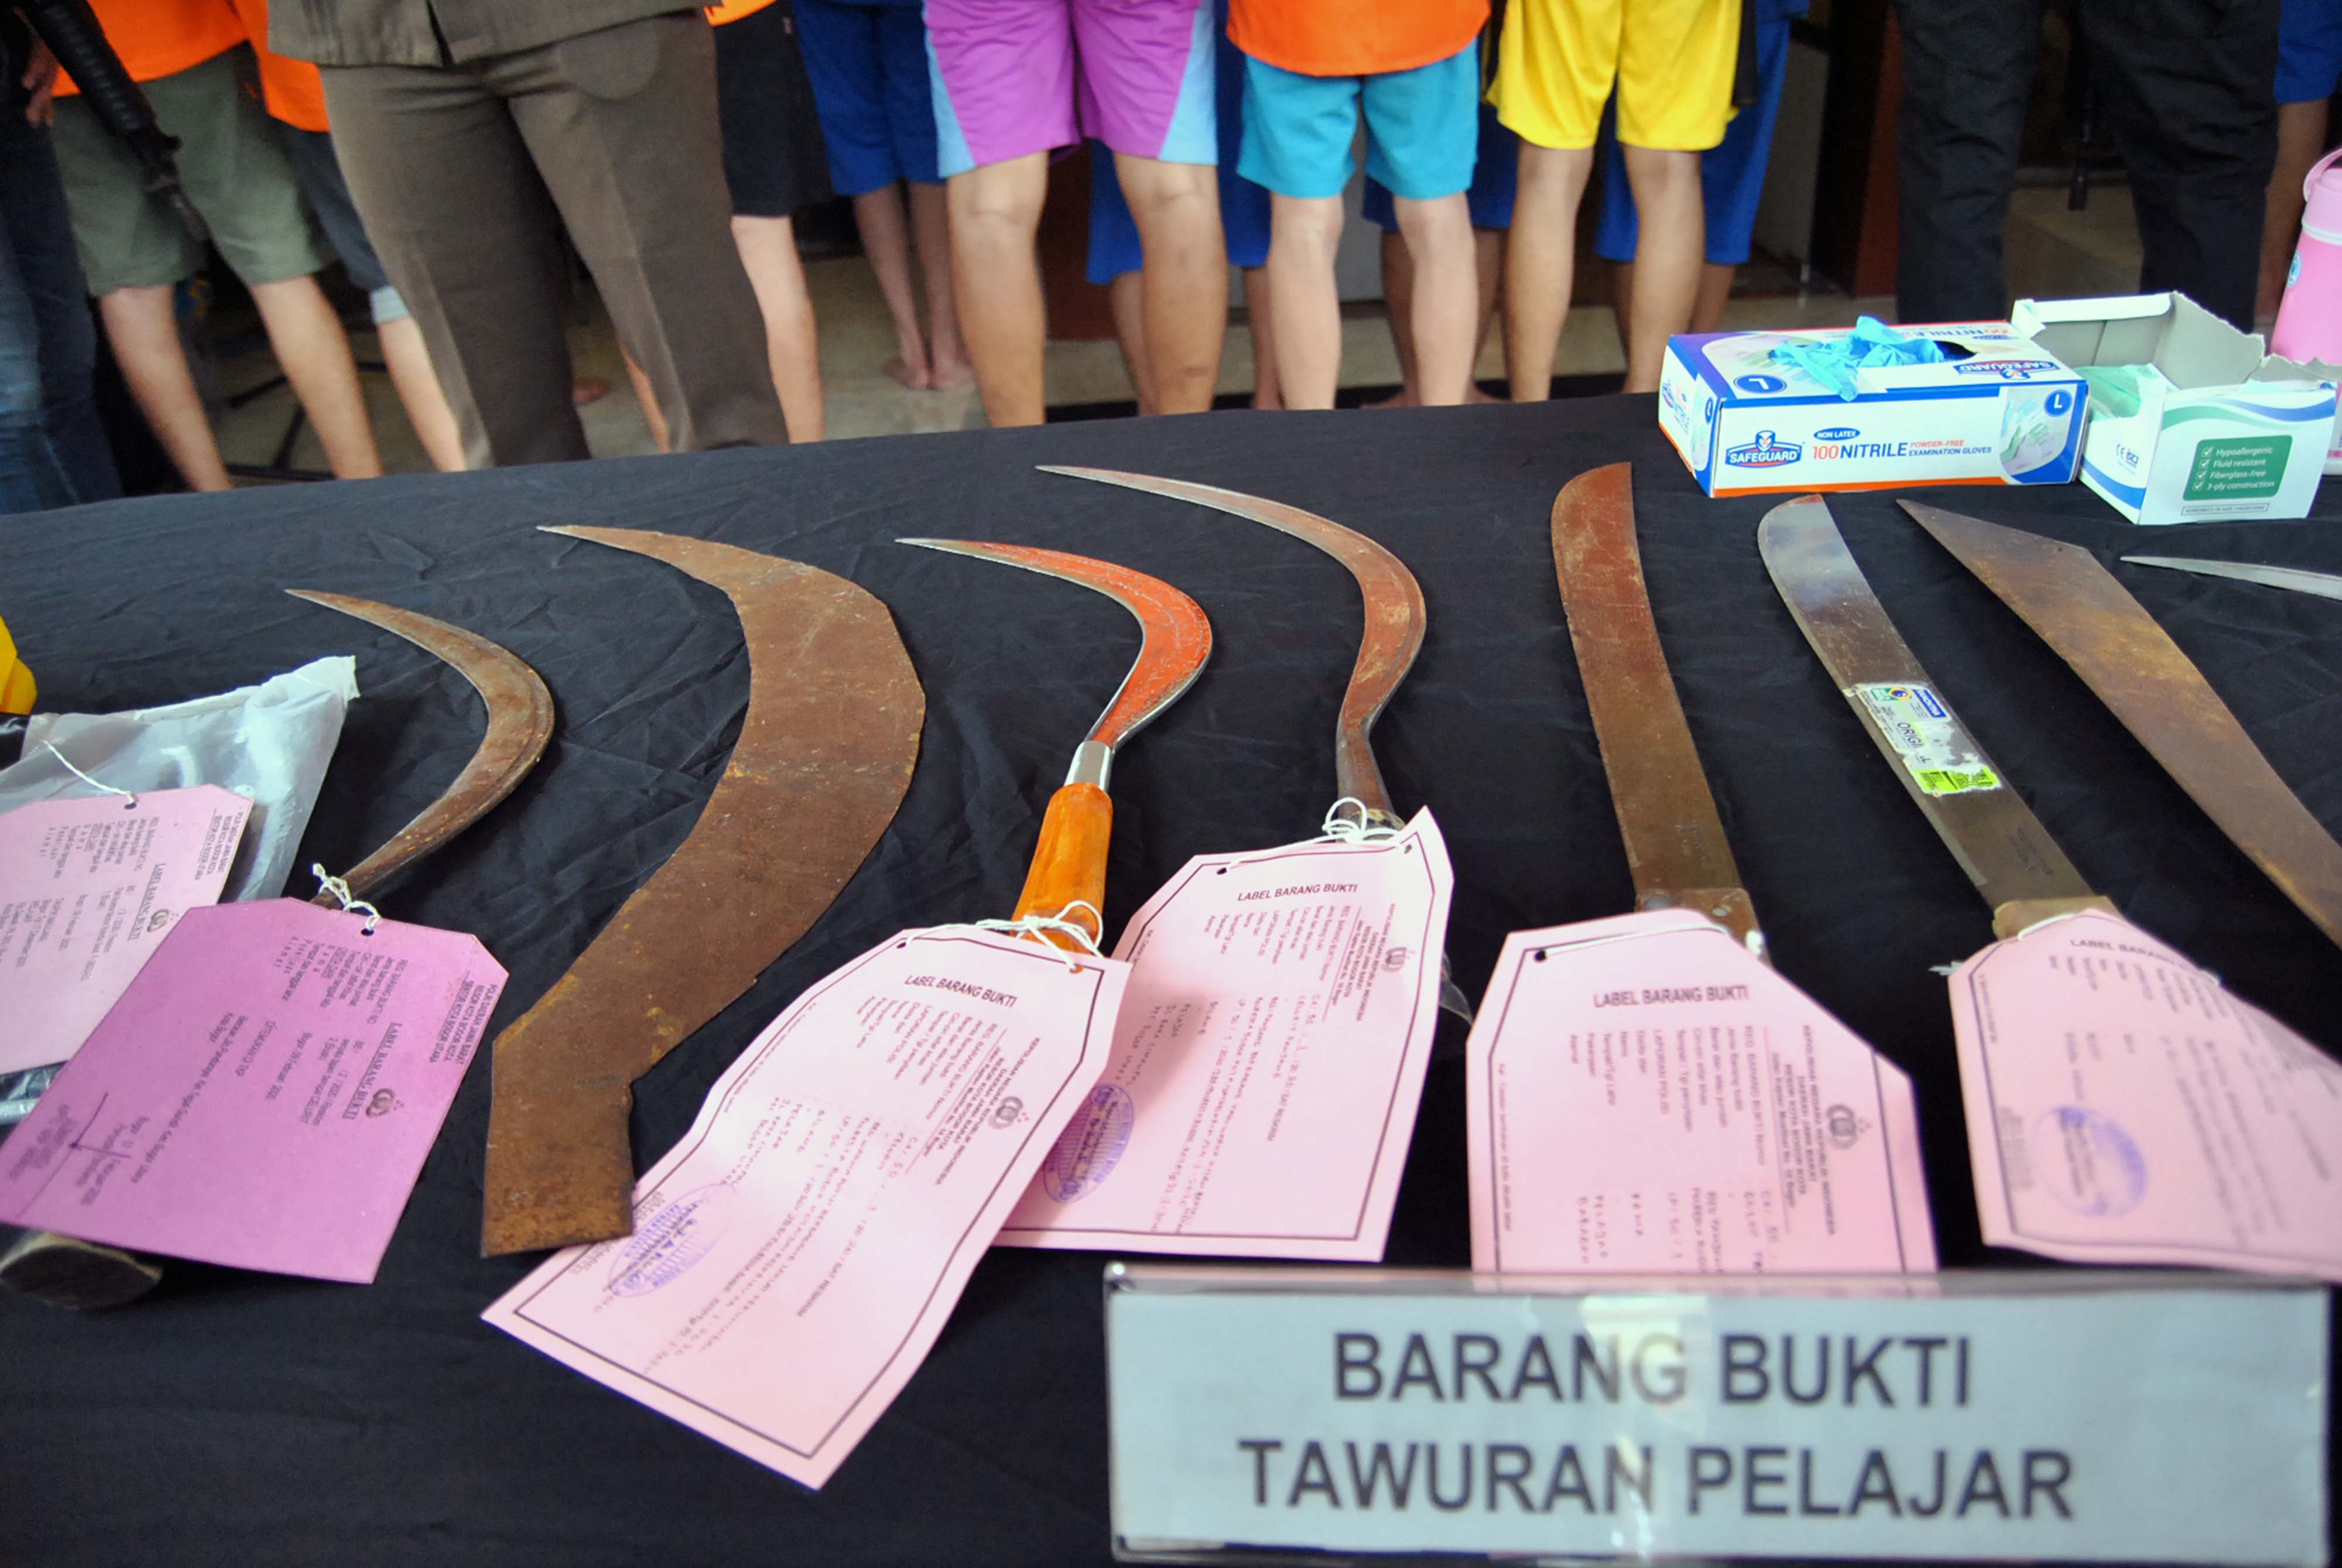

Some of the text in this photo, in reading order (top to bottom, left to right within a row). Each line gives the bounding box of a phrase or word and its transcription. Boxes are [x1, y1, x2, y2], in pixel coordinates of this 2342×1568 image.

[1960, 361, 2051, 371] SAFEGUARD
[2054, 394, 2063, 409] L
[1813, 442, 1908, 459] 100 NITRILE
[1908, 448, 1960, 456] EXAMINATION
[1909, 440, 1964, 448] POWDER-FREE
[2216, 447, 2273, 457] Hypoallergenic
[1729, 451, 1797, 463] SAFEGUARD
[2213, 458, 2266, 468] Fluid resistant
[2210, 470, 2266, 480] Fiberglass-free
[2227, 481, 2275, 489] construction
[1238, 884, 1358, 901] LABEL BARANG BUKTI
[2070, 939, 2117, 950] LABEL
[905, 975, 1018, 1008] LABEL BARANG BUKTI
[1594, 985, 1748, 1008] LABEL BARANG BUKTI
[451, 1022, 468, 1044] BOGOR
[958, 1041, 985, 1073] BARANG
[342, 1022, 403, 1120] LABEL BARANG BUKTI
[971, 1082, 987, 1101] KOTA
[988, 1077, 1012, 1106] NEGARA
[953, 1068, 1008, 1144] DAERAH JAWA BARAT
[953, 1102, 974, 1129] BOGOR
[964, 1107, 991, 1144] REPUBLIK
[937, 1130, 954, 1150] KOTA
[936, 1145, 965, 1185] INDONESIA
[1336, 1331, 1968, 1406] BARANG BUKTI
[1239, 1440, 2073, 1519] TAWURAN PELAJAR
